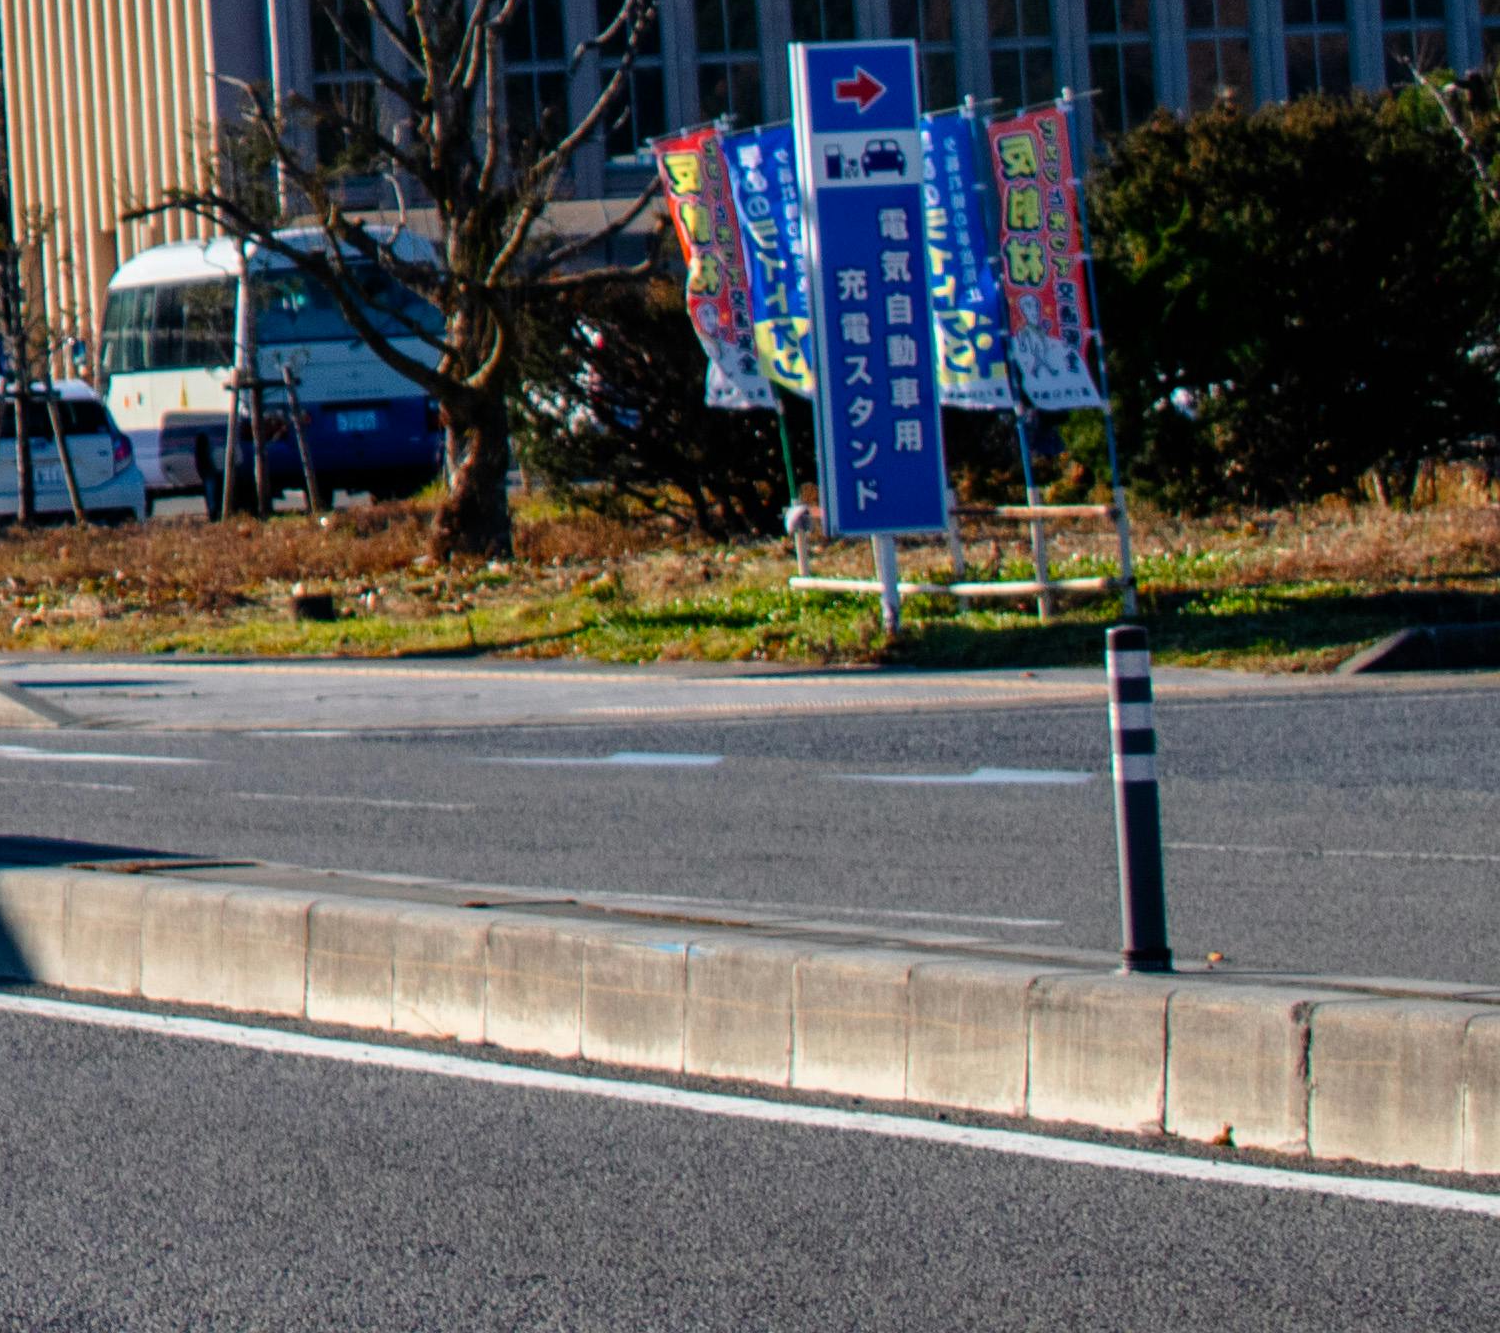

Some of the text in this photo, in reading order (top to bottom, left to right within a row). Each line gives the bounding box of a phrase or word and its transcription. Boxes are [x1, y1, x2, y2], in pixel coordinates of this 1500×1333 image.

[836, 267, 881, 513] 充電スタンド
[878, 207, 924, 453] 電気自動車用
